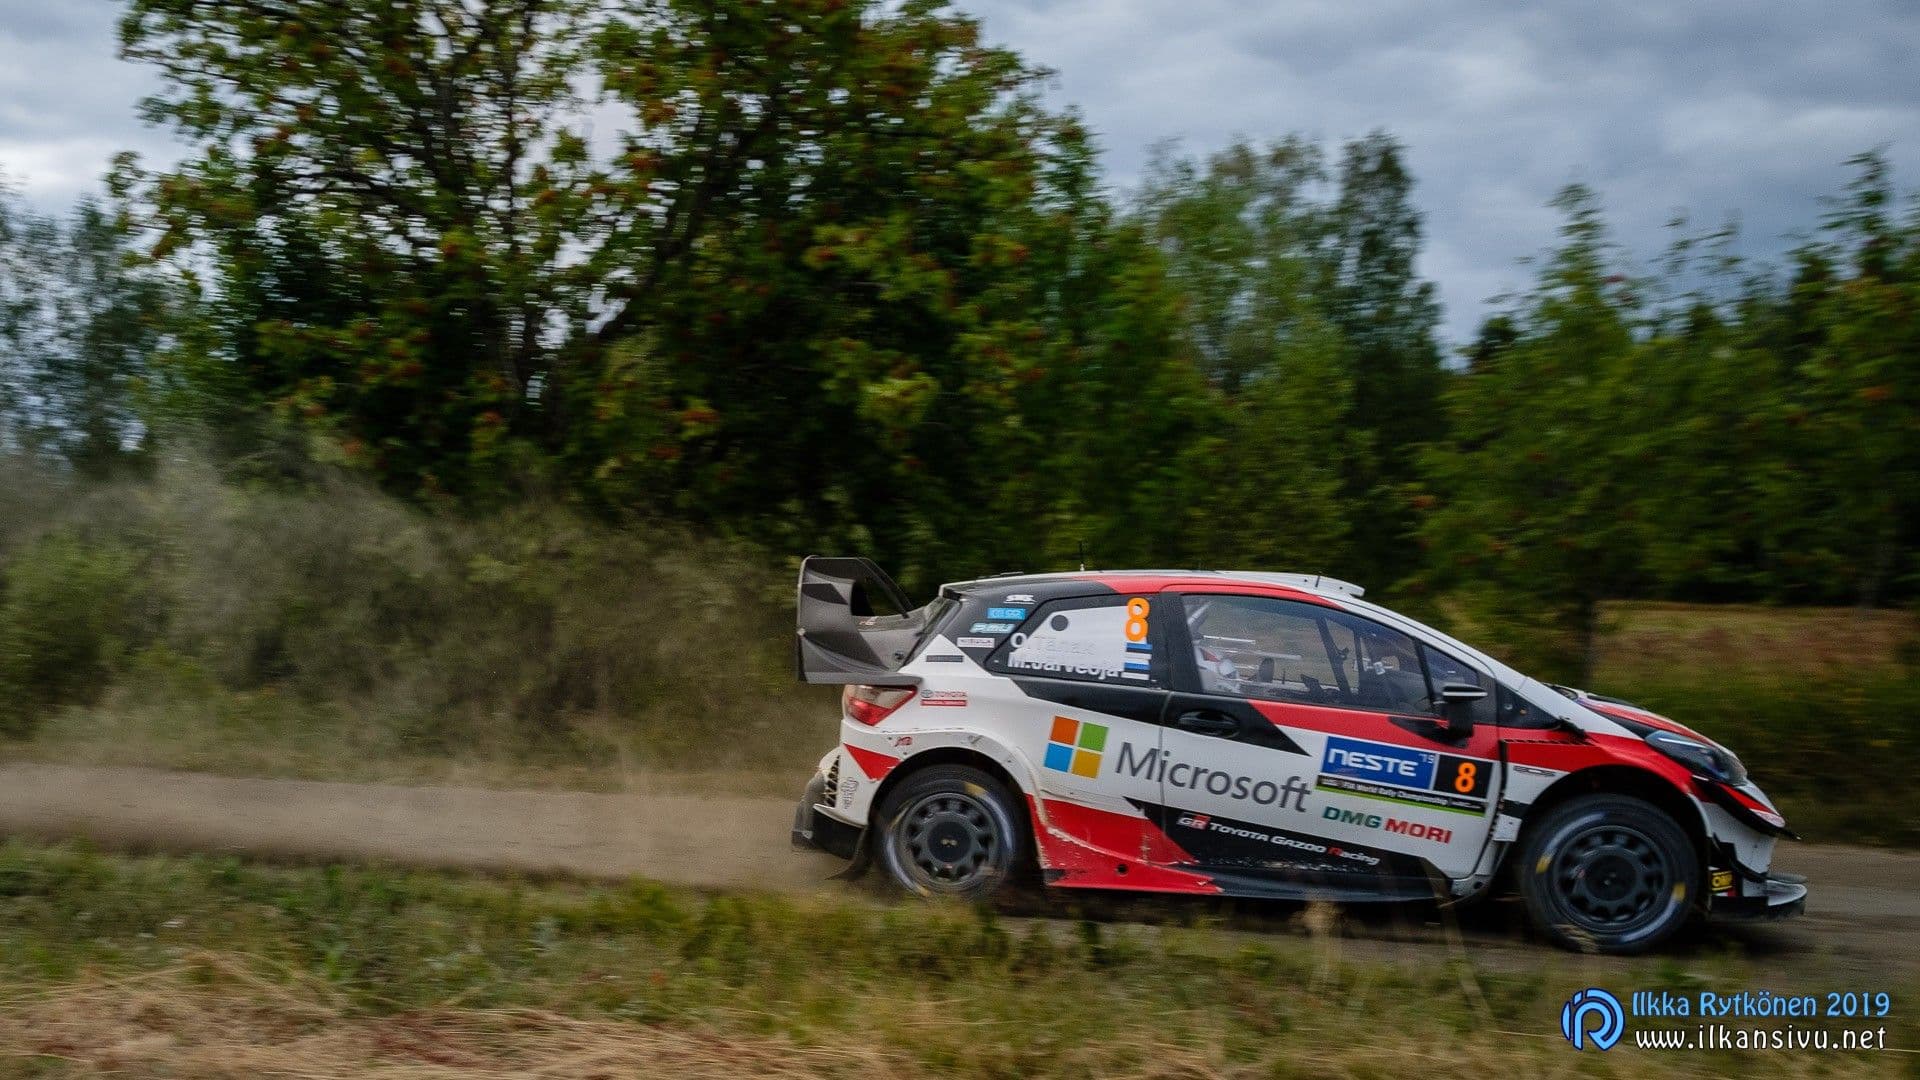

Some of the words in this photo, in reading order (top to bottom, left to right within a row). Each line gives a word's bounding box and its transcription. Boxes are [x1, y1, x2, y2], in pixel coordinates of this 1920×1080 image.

[1124, 597, 1150, 642] 8
[1115, 741, 1312, 813] Microsoft
[1328, 748, 1419, 777] NESTE
[1454, 761, 1478, 793] 8
[1209, 822, 1269, 842] TOYOTA
[1270, 835, 1327, 853] GAZOO
[1327, 846, 1381, 866] Racing
[1323, 806, 1382, 829] DMG
[1385, 817, 1454, 844] MORI
